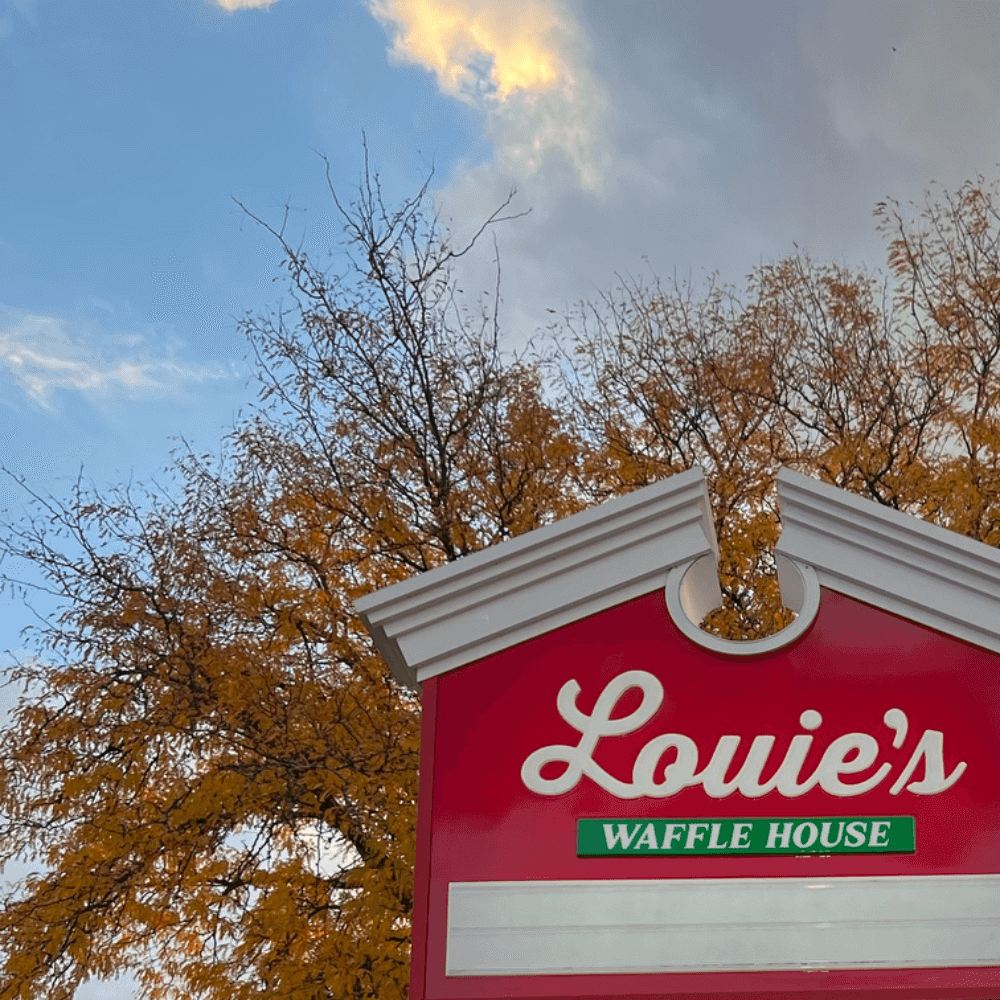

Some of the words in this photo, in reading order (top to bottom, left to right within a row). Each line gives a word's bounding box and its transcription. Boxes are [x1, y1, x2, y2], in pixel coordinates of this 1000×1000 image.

[520, 670, 968, 799] Louie's
[602, 822, 753, 850] WAFFLE
[765, 821, 891, 849] HOUSE
